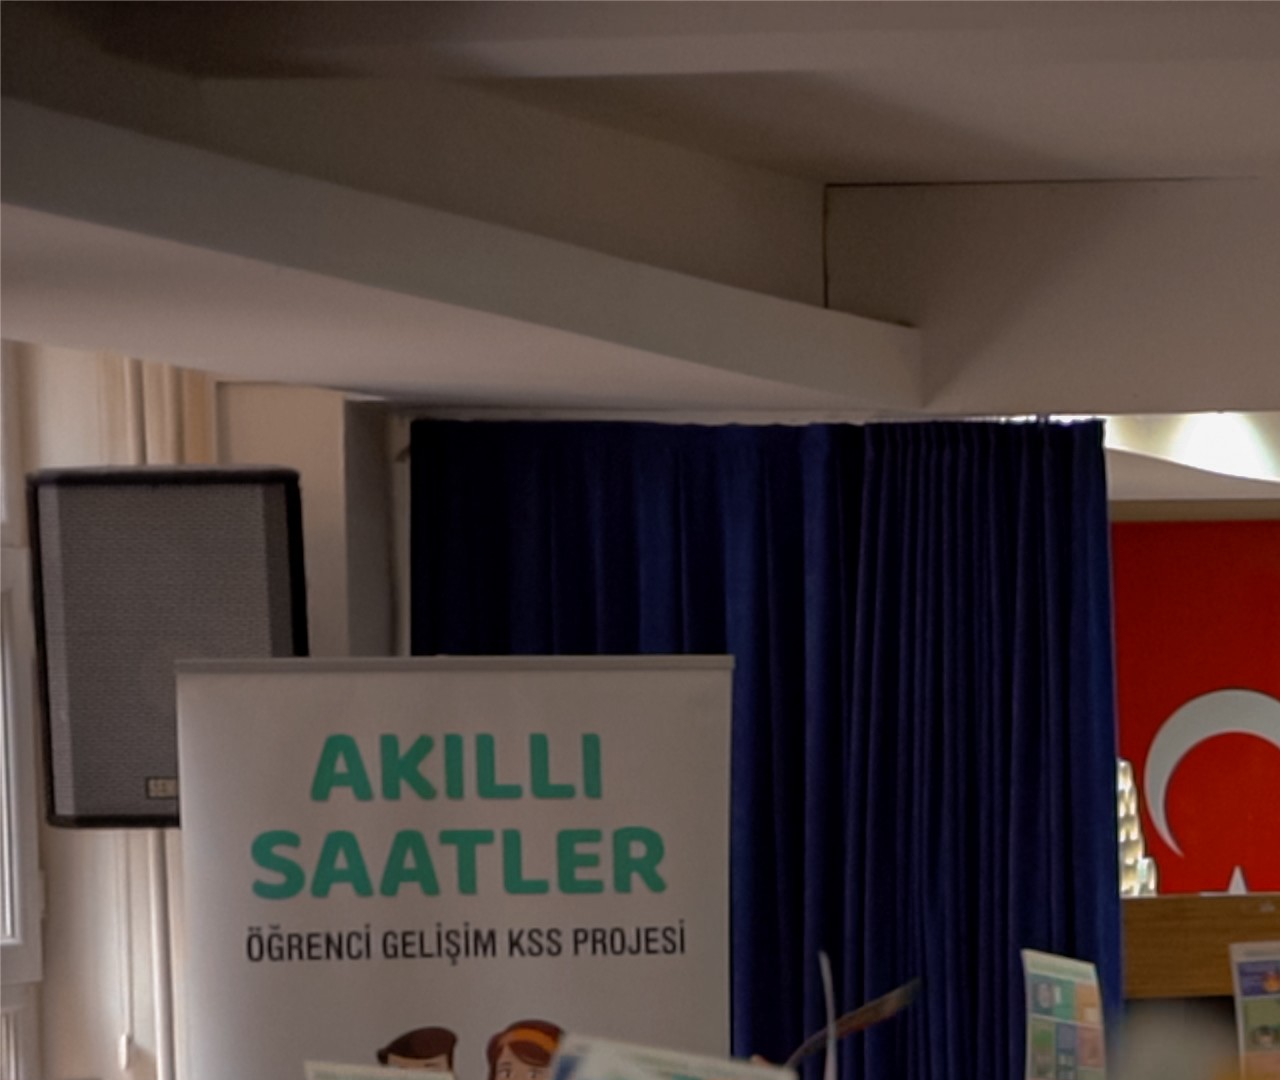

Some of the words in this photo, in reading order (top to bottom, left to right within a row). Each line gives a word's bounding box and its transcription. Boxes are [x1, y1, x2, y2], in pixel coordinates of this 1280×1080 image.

[310, 732, 602, 801] AKILLI
[251, 826, 667, 900] SAATLER
[246, 922, 372, 963] ÖĞRENCİ
[381, 921, 497, 967] GELİŞİM
[508, 928, 564, 957] KSS
[572, 919, 686, 957] PROJESİ
